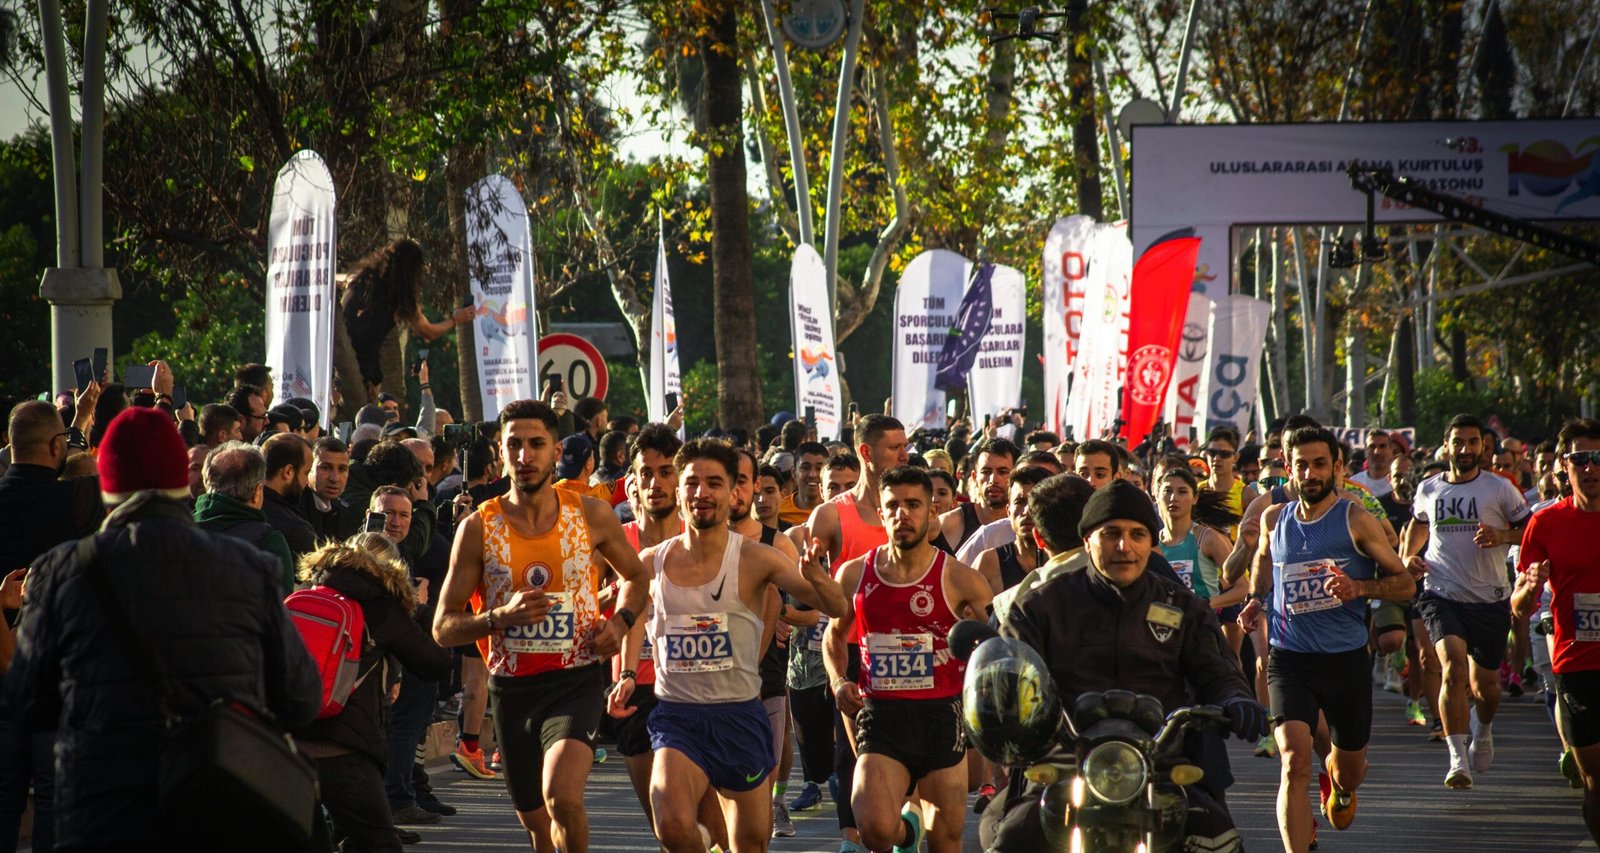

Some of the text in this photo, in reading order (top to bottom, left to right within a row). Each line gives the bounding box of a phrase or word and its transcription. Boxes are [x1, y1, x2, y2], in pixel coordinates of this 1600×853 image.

[1209, 159, 1484, 174] ULUSLARARASI AANA KURTULUŞ
[922, 294, 945, 310] TÜM
[899, 314, 955, 328] SPORCULA
[979, 340, 1020, 353] AŞARILAR
[669, 634, 729, 659] 3002
[875, 654, 928, 677] 3134
